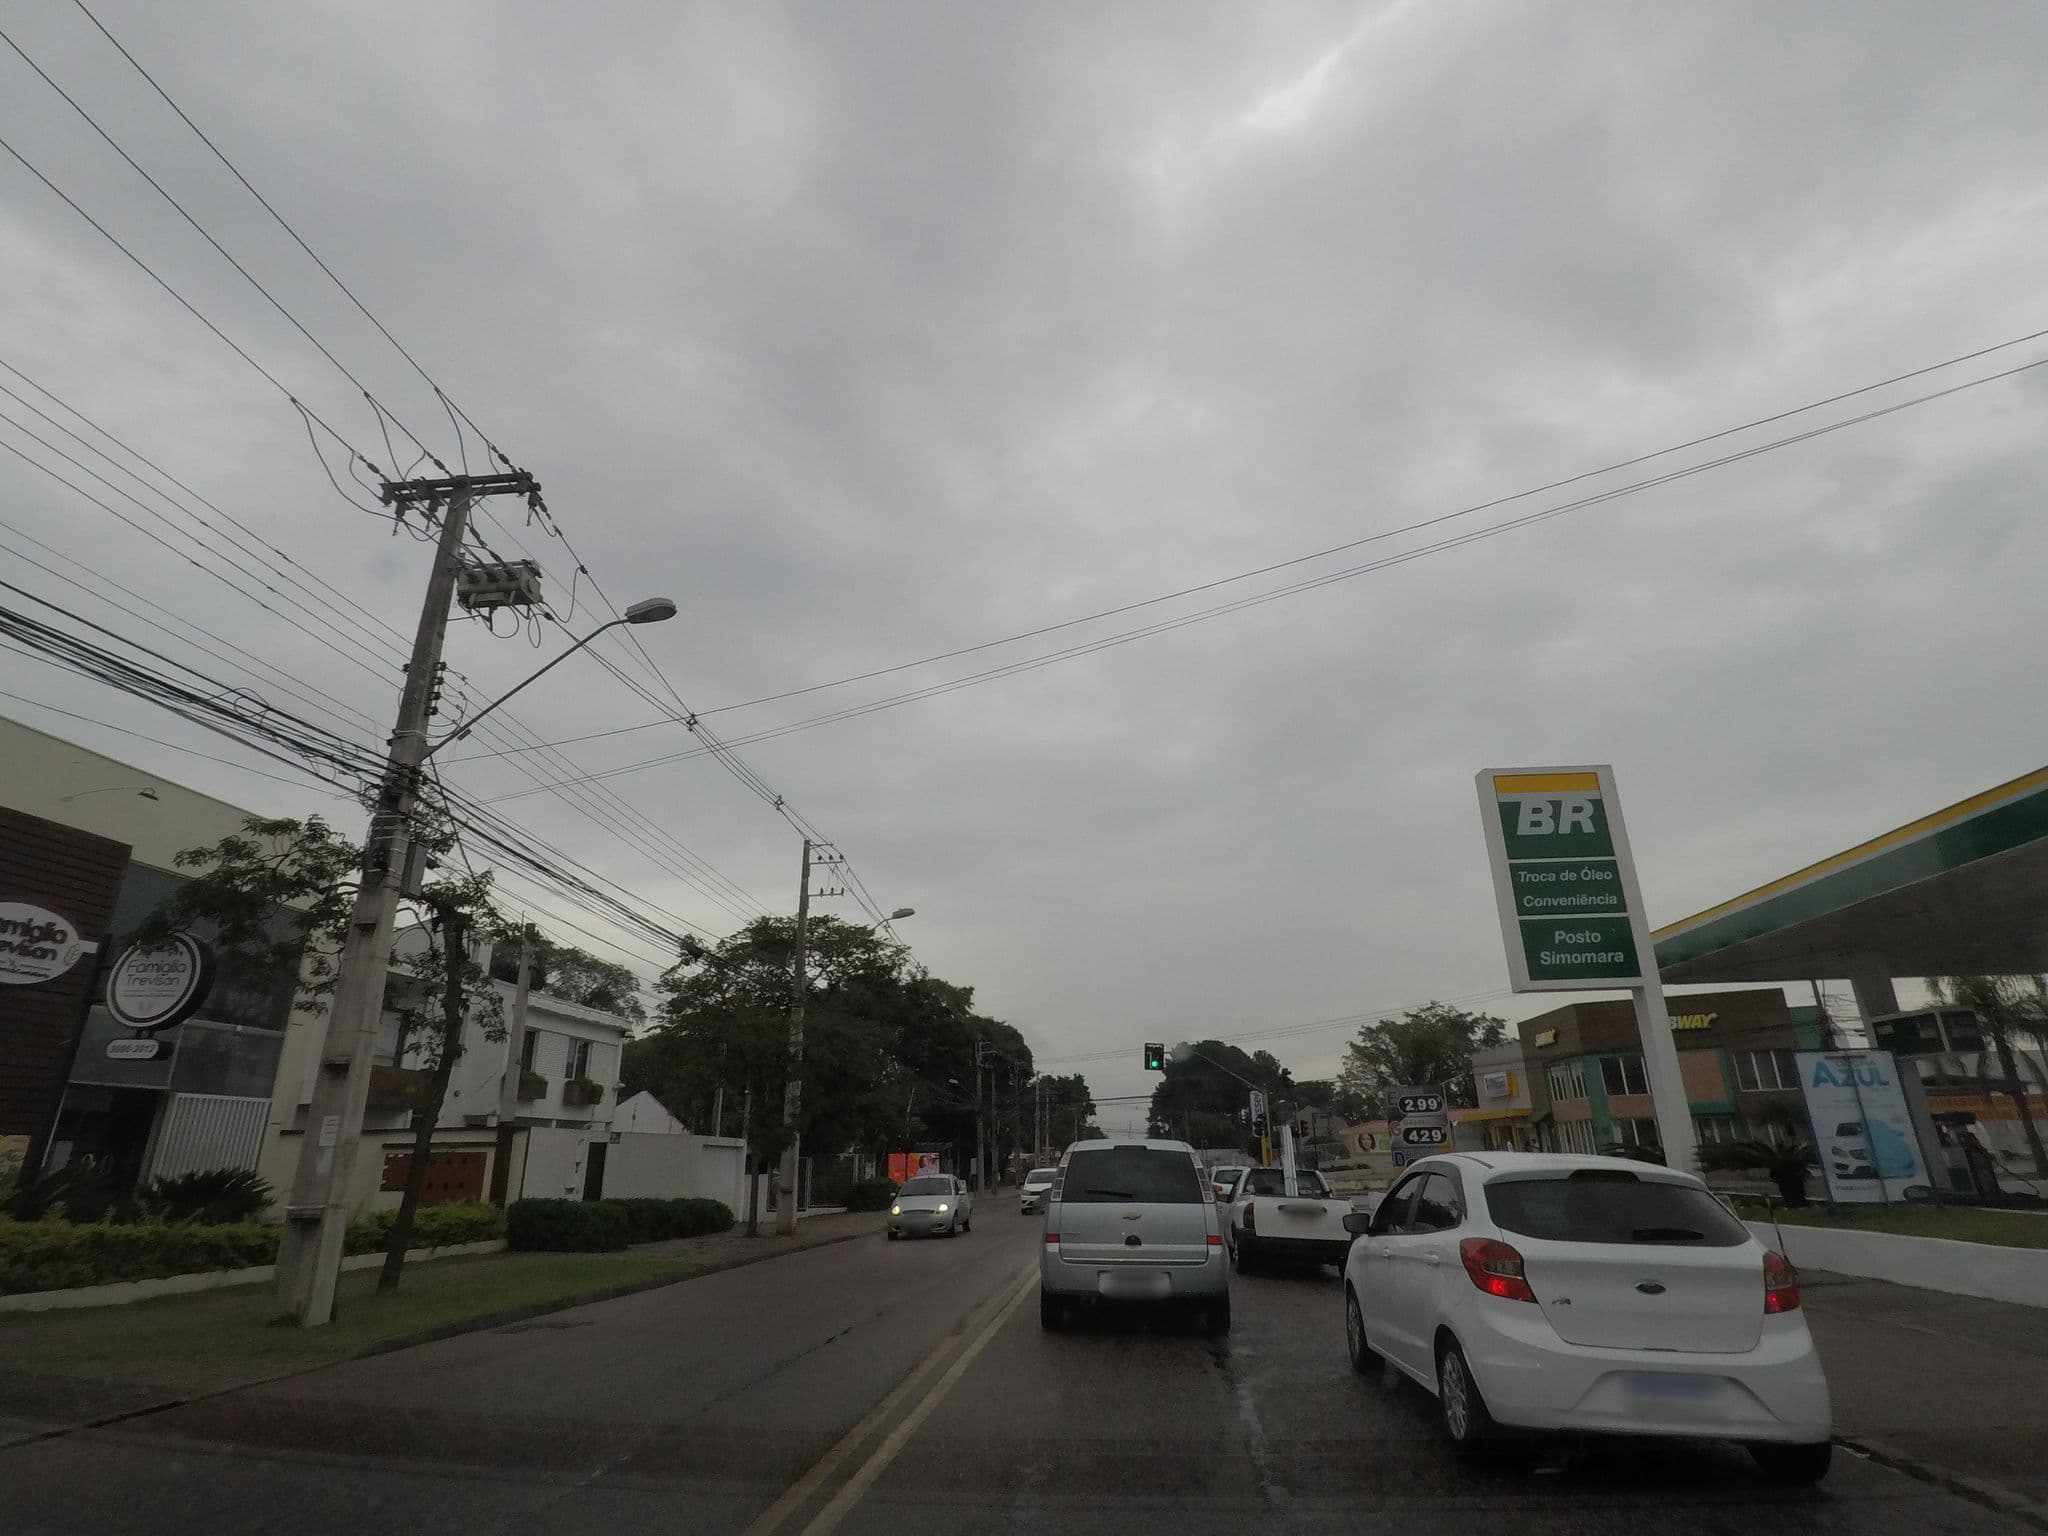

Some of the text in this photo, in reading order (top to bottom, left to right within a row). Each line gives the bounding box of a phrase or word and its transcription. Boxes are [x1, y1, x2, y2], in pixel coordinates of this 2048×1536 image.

[1516, 798, 1596, 836] BR
[1517, 866, 1613, 883] Troca de Óleo
[1523, 893, 1618, 908] Conveniência
[1554, 929, 1602, 945] Posto
[1539, 950, 1625, 966] Simomara
[127, 974, 180, 986] Trevisan
